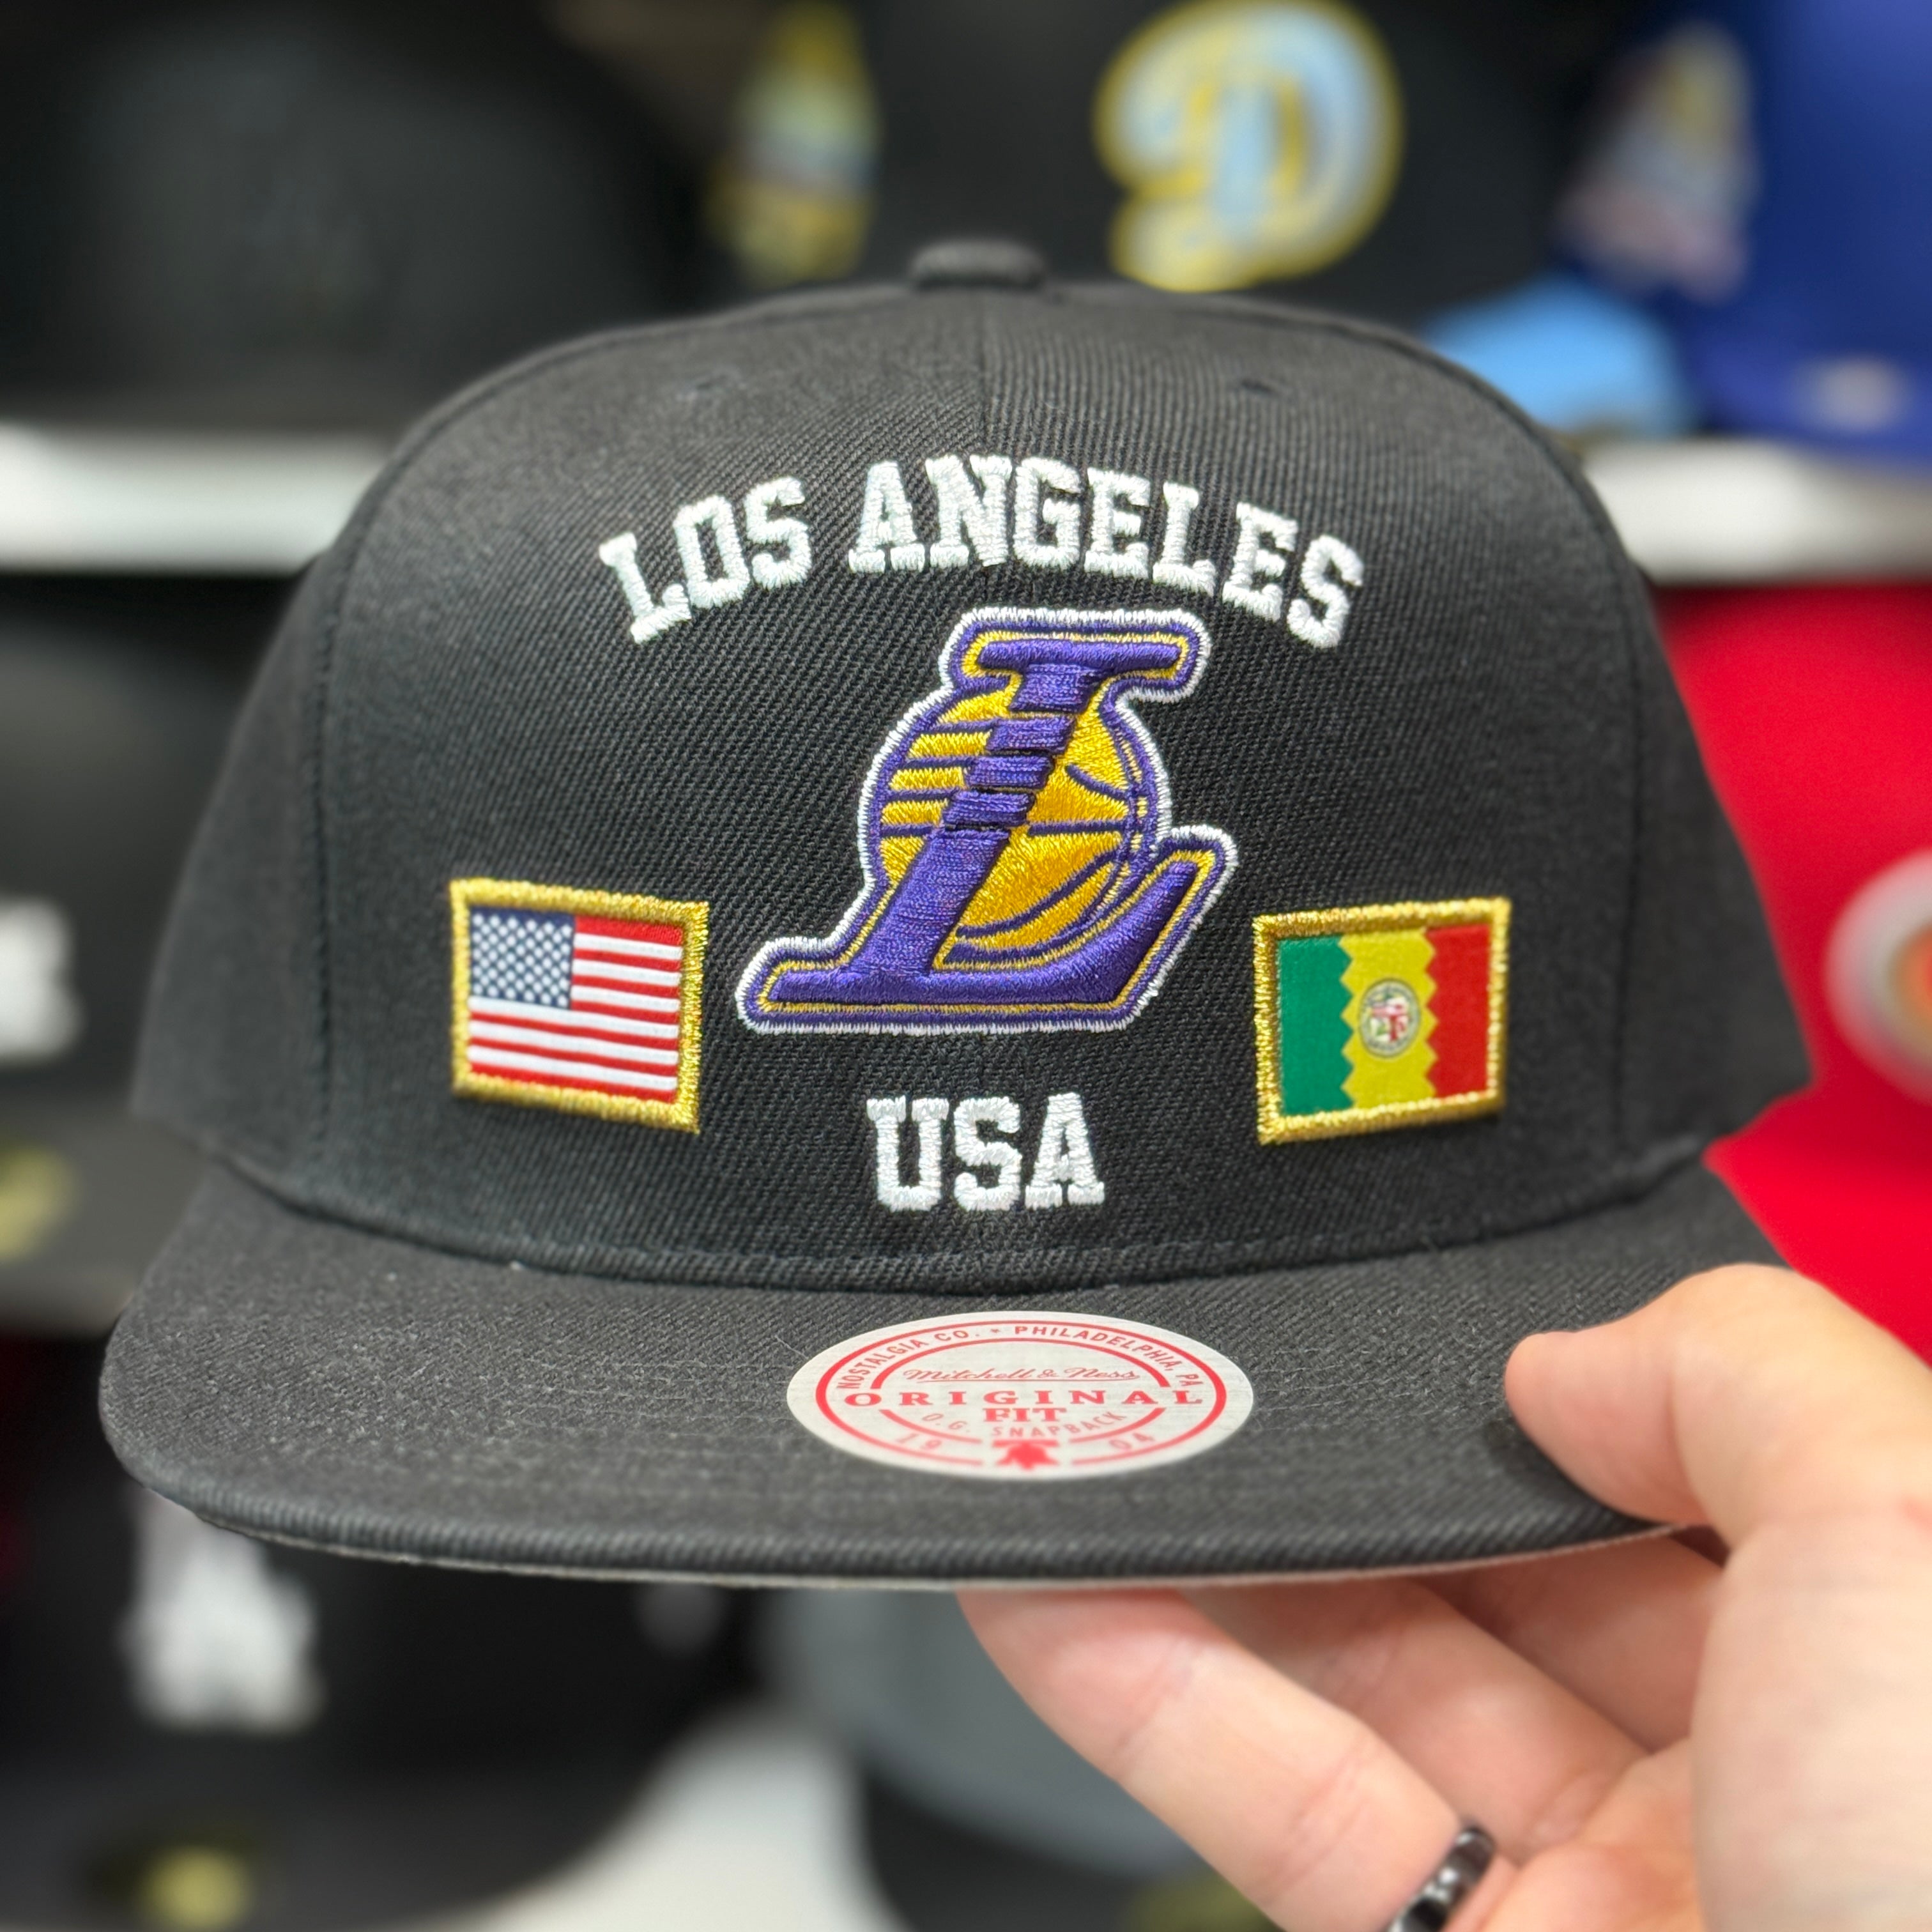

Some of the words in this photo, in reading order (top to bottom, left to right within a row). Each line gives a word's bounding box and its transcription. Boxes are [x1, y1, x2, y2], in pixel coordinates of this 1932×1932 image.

[599, 477, 813, 644] LOS
[848, 454, 1365, 649] ANGELES
[866, 1091, 1105, 1212] USA
[836, 1339, 929, 1389] NOSTALGIA
[934, 1330, 980, 1342] CO.
[1015, 1326, 1182, 1371] PHILADELPHIA,
[1176, 1373, 1204, 1386] PA
[903, 1368, 1036, 1380] Mitchell
[1037, 1370, 1061, 1379] &
[1063, 1367, 1140, 1380] Ness
[845, 1390, 1203, 1407] ORIGINAL
[922, 1413, 971, 1432] O.G.
[991, 1411, 1127, 1438] SNAPBACK
[982, 1407, 1068, 1423] FIT
